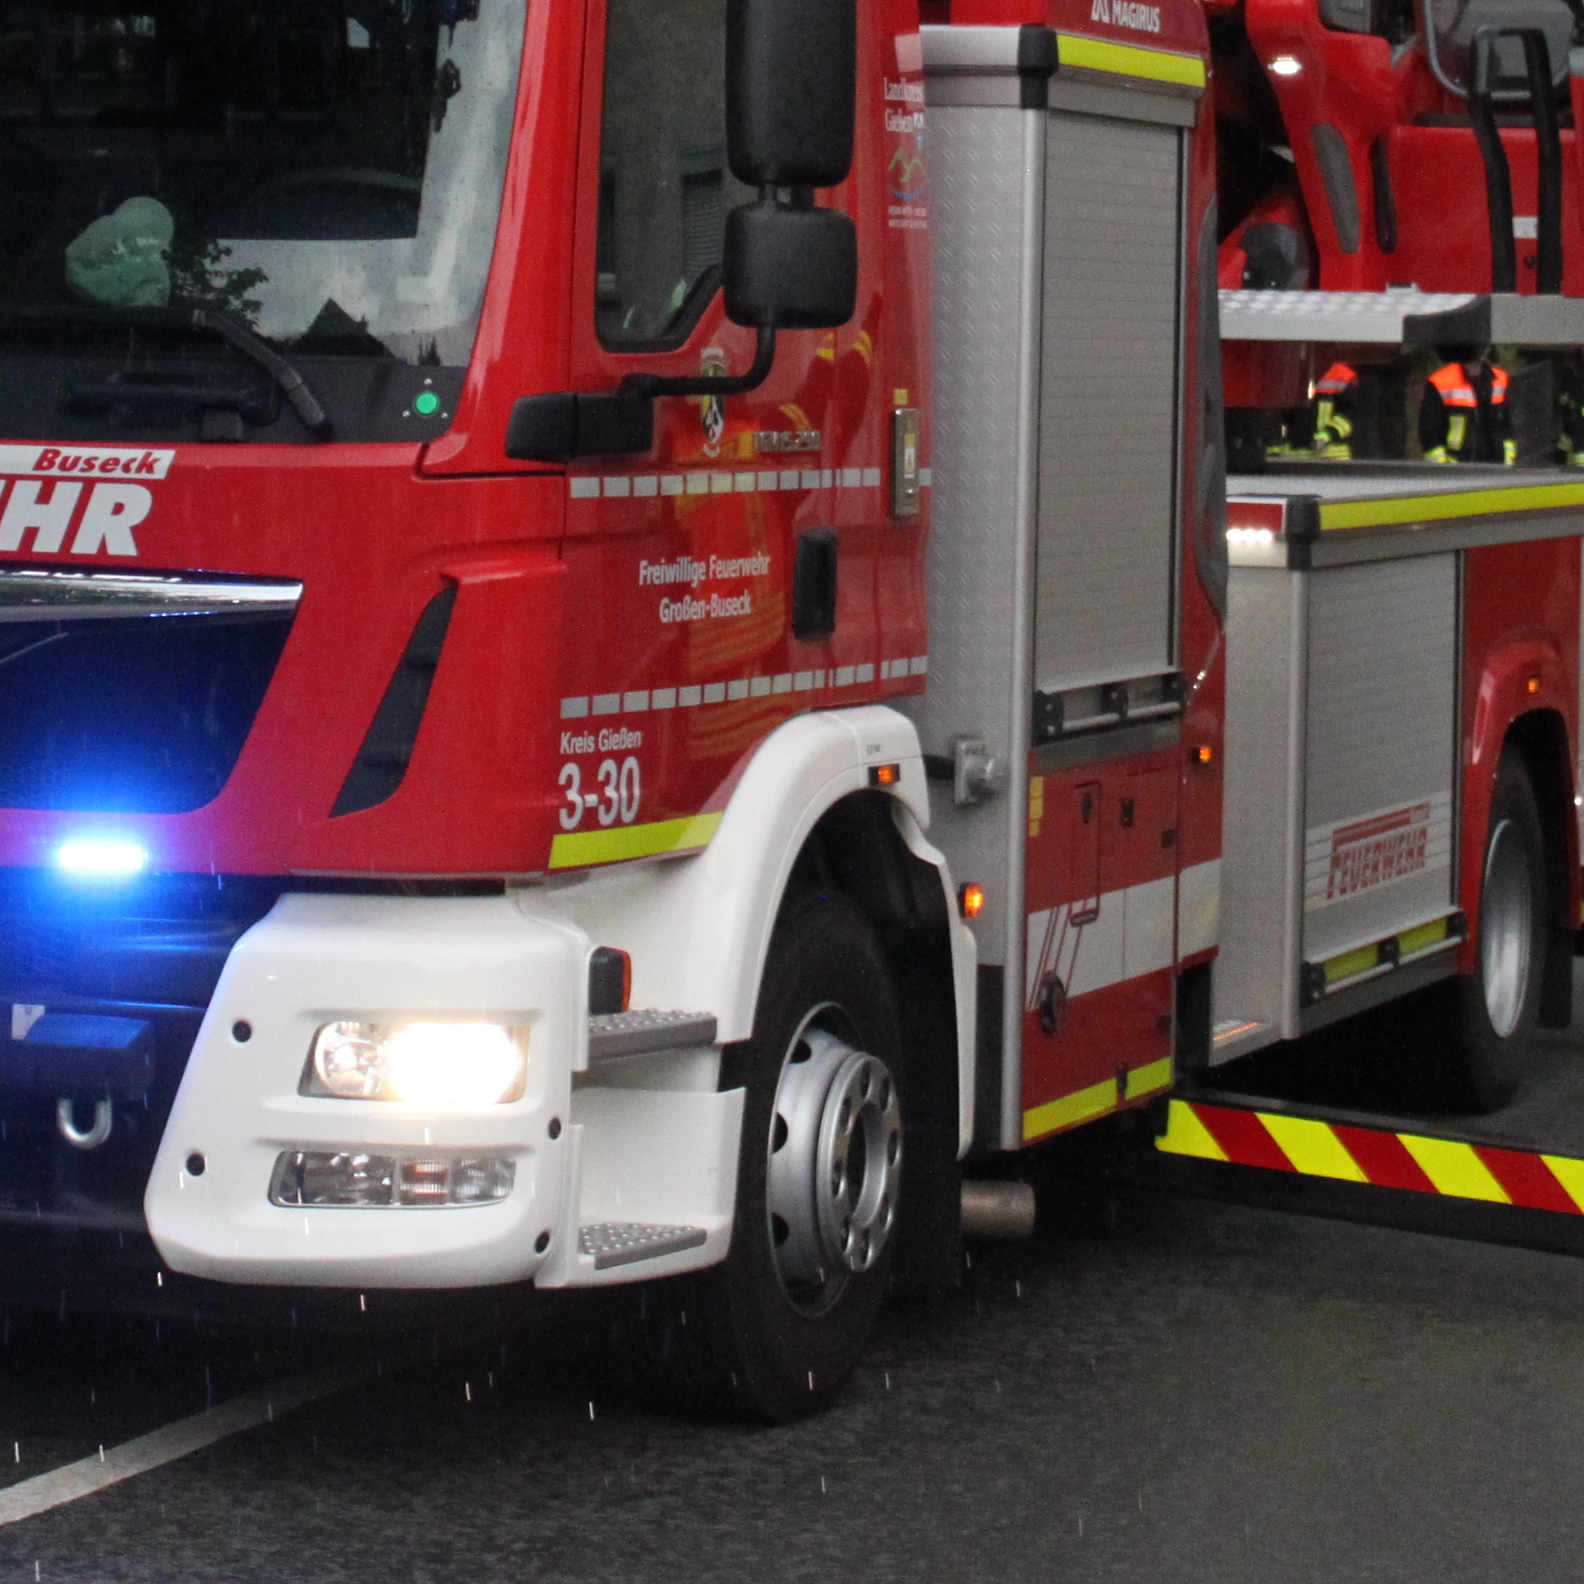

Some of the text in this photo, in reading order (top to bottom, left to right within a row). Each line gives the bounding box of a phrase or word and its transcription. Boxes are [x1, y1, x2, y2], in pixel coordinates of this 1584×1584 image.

[33, 447, 162, 475] Buseck
[639, 551, 771, 588] Freiwillige Feuerwehr
[659, 589, 752, 624] Großen-Buseck
[560, 727, 642, 755] Kreis Gießen
[558, 756, 641, 830] 3-30
